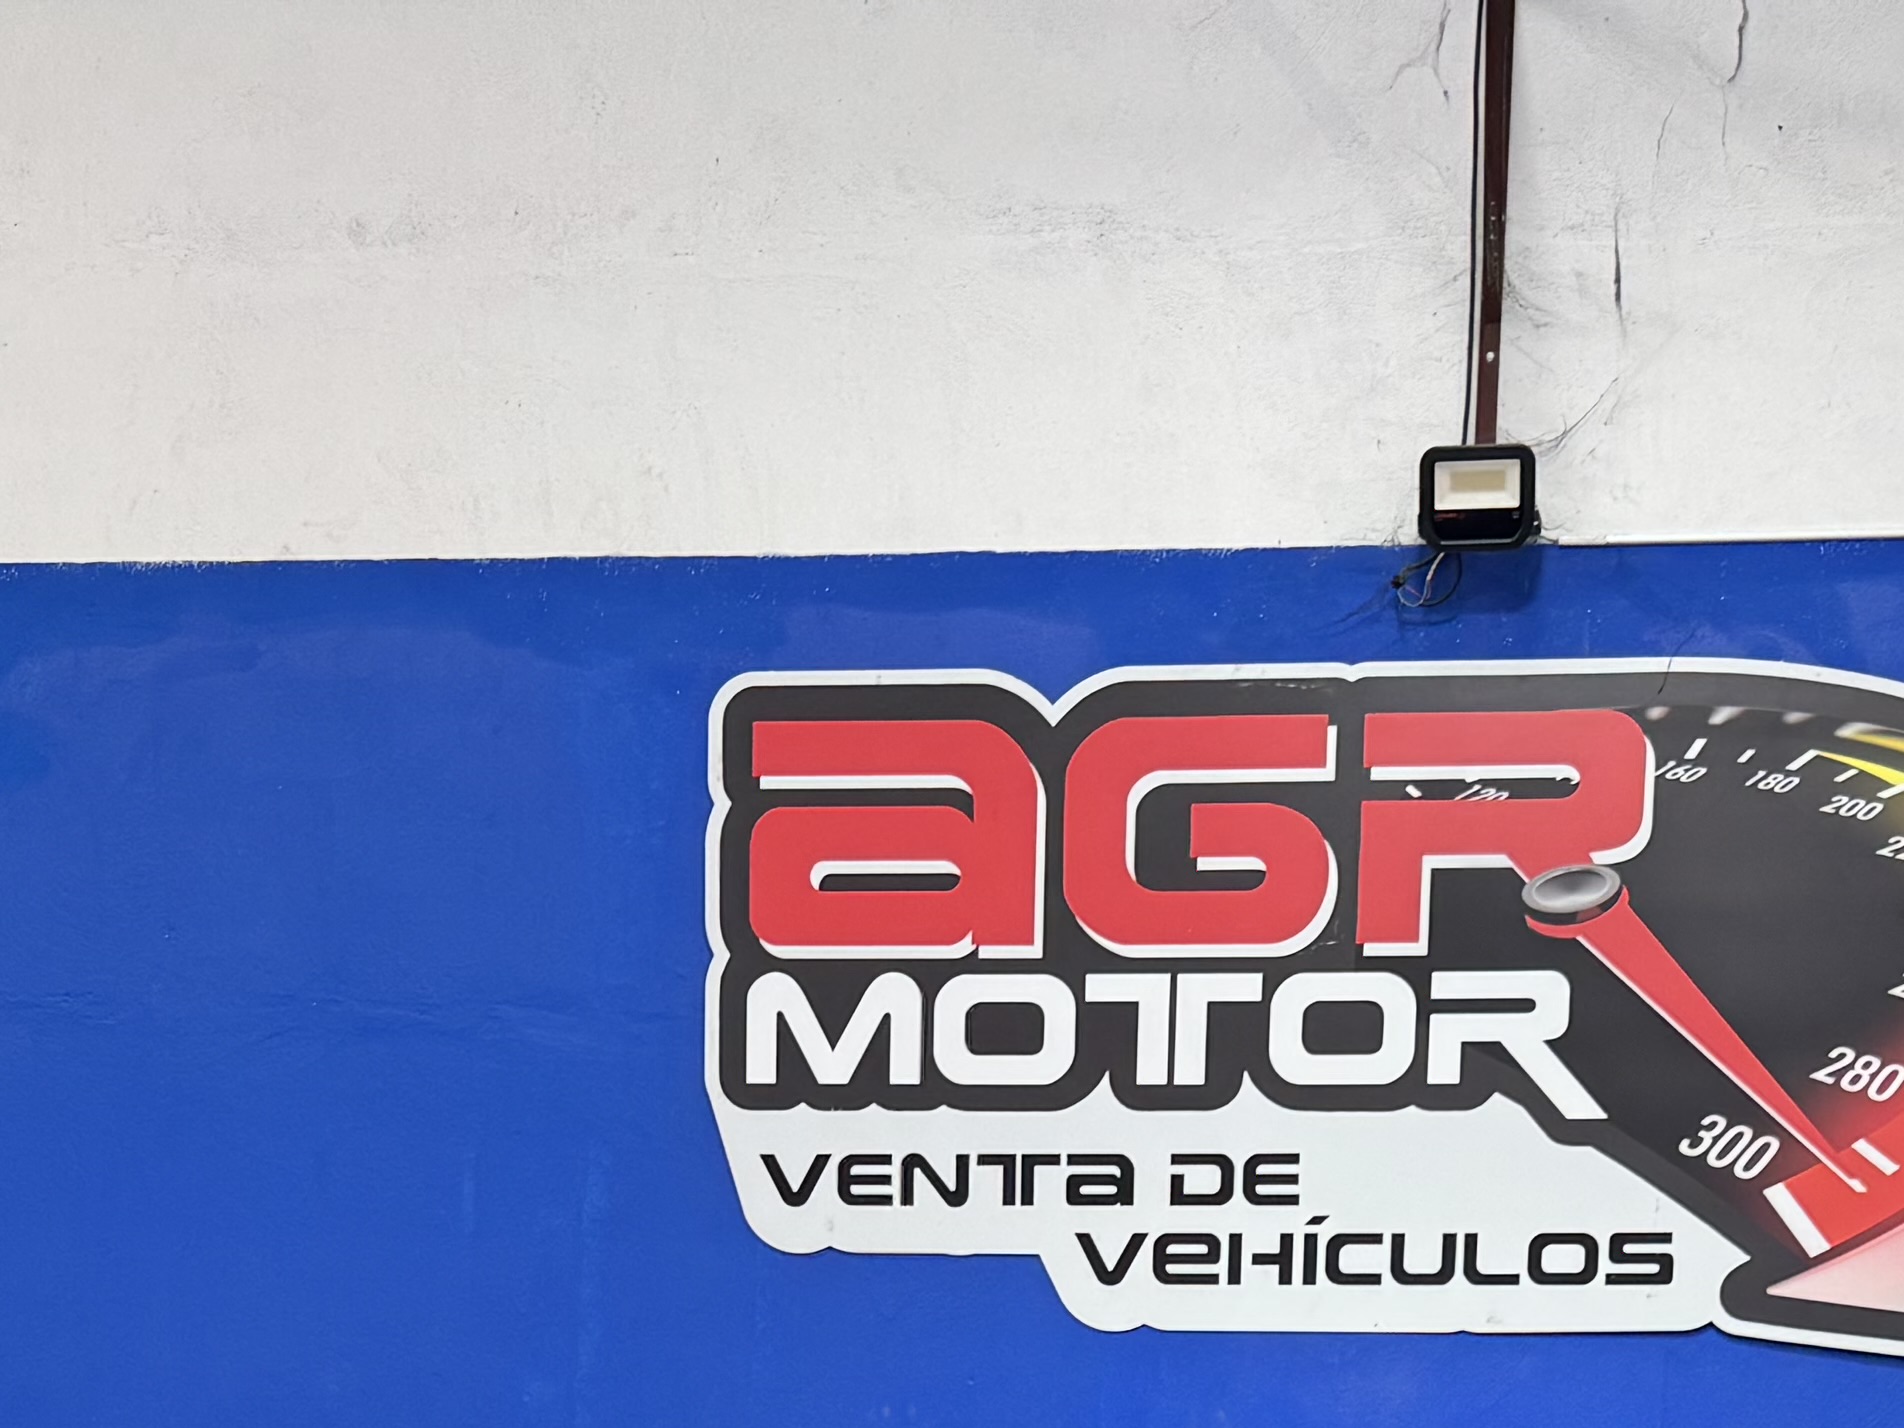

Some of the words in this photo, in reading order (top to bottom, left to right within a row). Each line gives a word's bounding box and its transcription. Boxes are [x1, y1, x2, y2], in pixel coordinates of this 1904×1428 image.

[1654, 759, 1708, 784] 160
[1743, 767, 1802, 794] 180
[1818, 794, 1884, 822] 200
[745, 970, 1610, 1120] MOTOR
[1677, 1113, 1781, 1180] 300
[1168, 1152, 1301, 1208] DE
